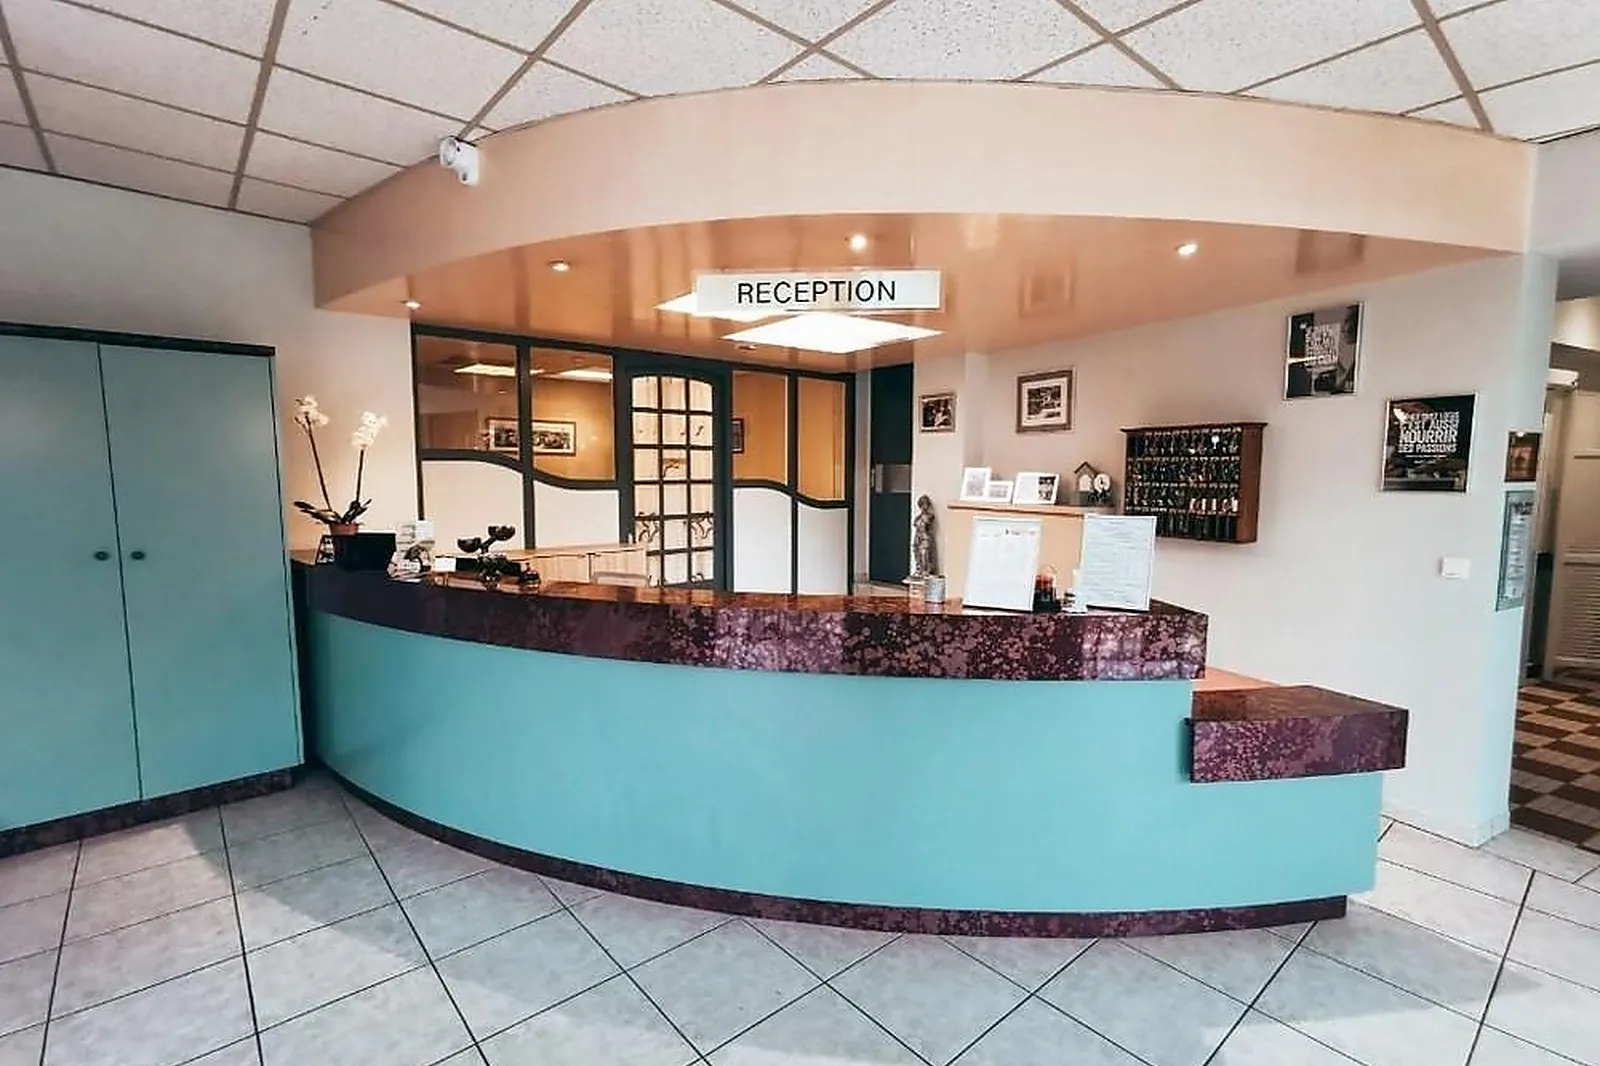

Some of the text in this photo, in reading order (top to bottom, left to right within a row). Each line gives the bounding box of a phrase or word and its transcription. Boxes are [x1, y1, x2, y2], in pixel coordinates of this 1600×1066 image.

[737, 280, 896, 304] RECEPTION
[1399, 428, 1458, 443] NOURRIR
[1415, 443, 1458, 453] PASSIONS
